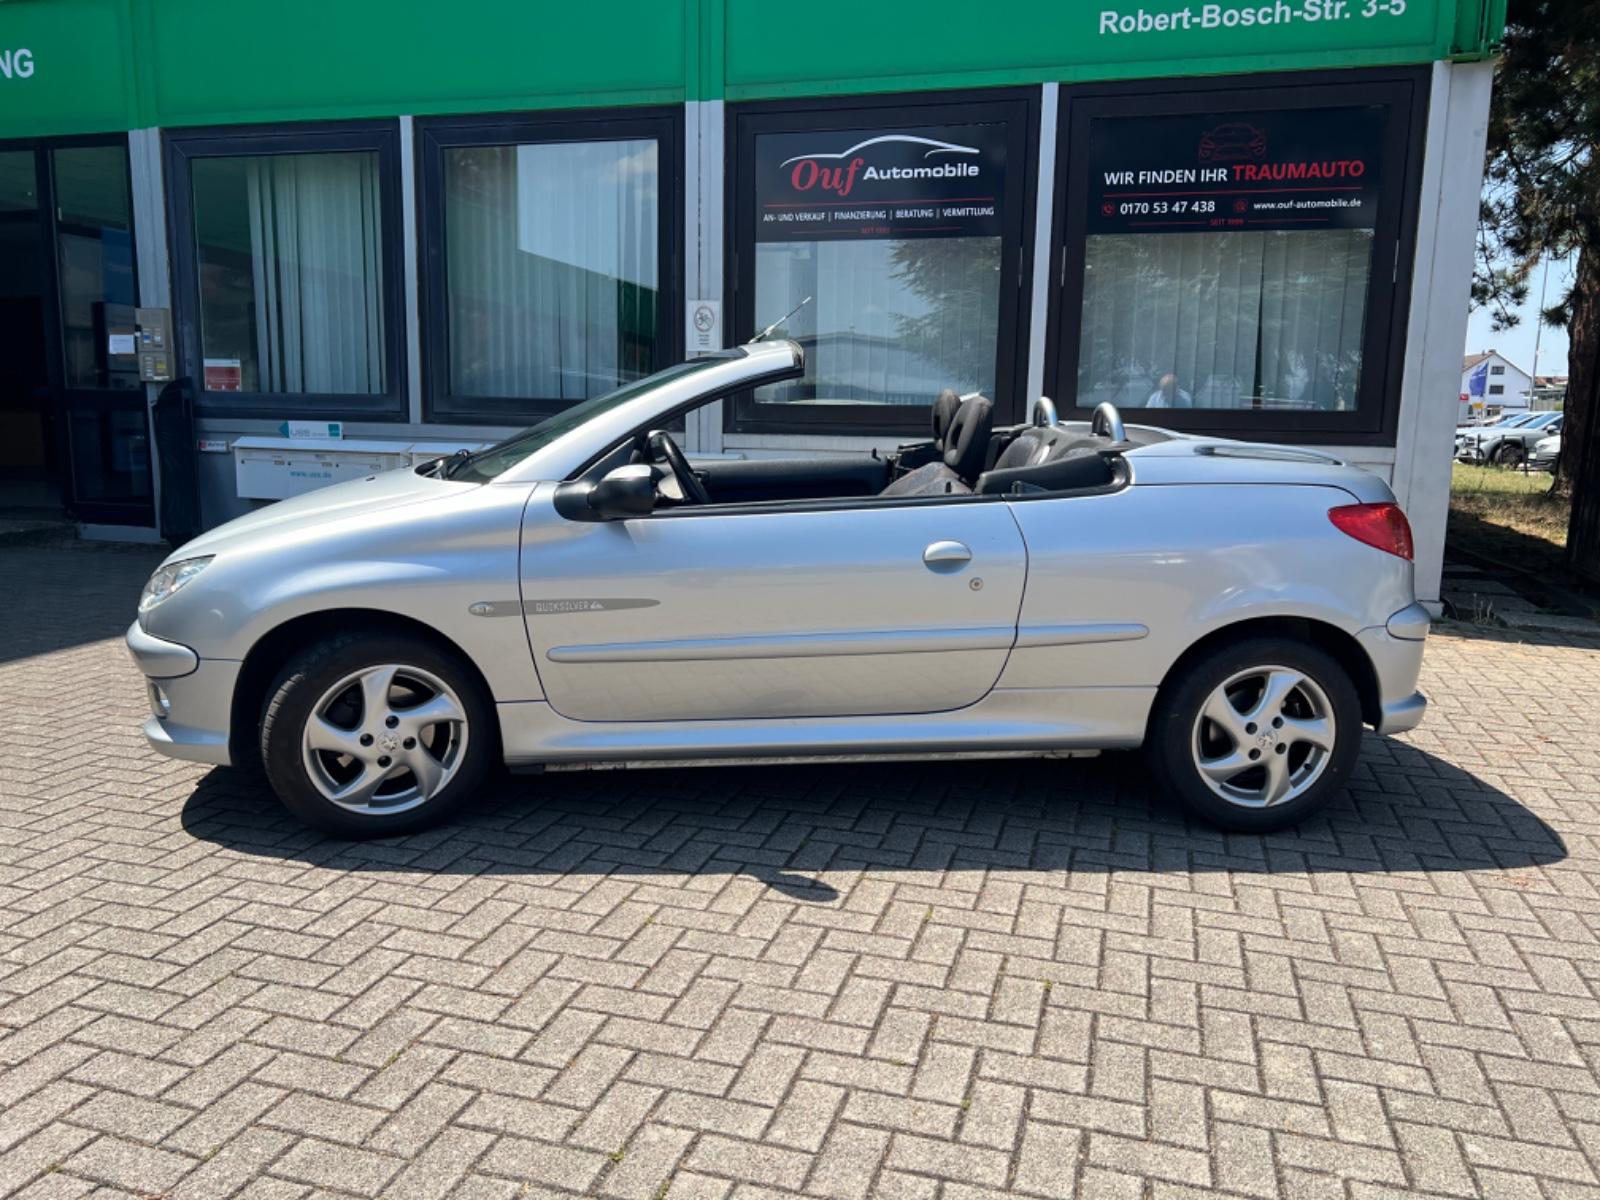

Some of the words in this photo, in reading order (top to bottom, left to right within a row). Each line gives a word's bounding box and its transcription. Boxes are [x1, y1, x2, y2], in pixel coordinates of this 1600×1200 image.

[1099, 0, 1351, 34] Robert-Bosch-Str.
[1361, 0, 1406, 17] 3-5
[791, 158, 864, 196] Ouf
[863, 163, 979, 180] Automobile
[1104, 171, 1134, 185] WIR
[1138, 169, 1196, 184] FINDEN
[1200, 168, 1228, 182] IHR
[1233, 160, 1364, 181] TRAUMAUTO
[834, 210, 887, 220] FINANZIERUNG
[895, 208, 934, 219] BERATUNG
[942, 206, 994, 217] VERMITTLUNG
[1119, 202, 1149, 215] 0170
[1152, 202, 1168, 213] 53
[1171, 201, 1188, 213] 47
[1191, 200, 1216, 212] 438
[1253, 199, 1362, 209] www.ouf-automobile.de
